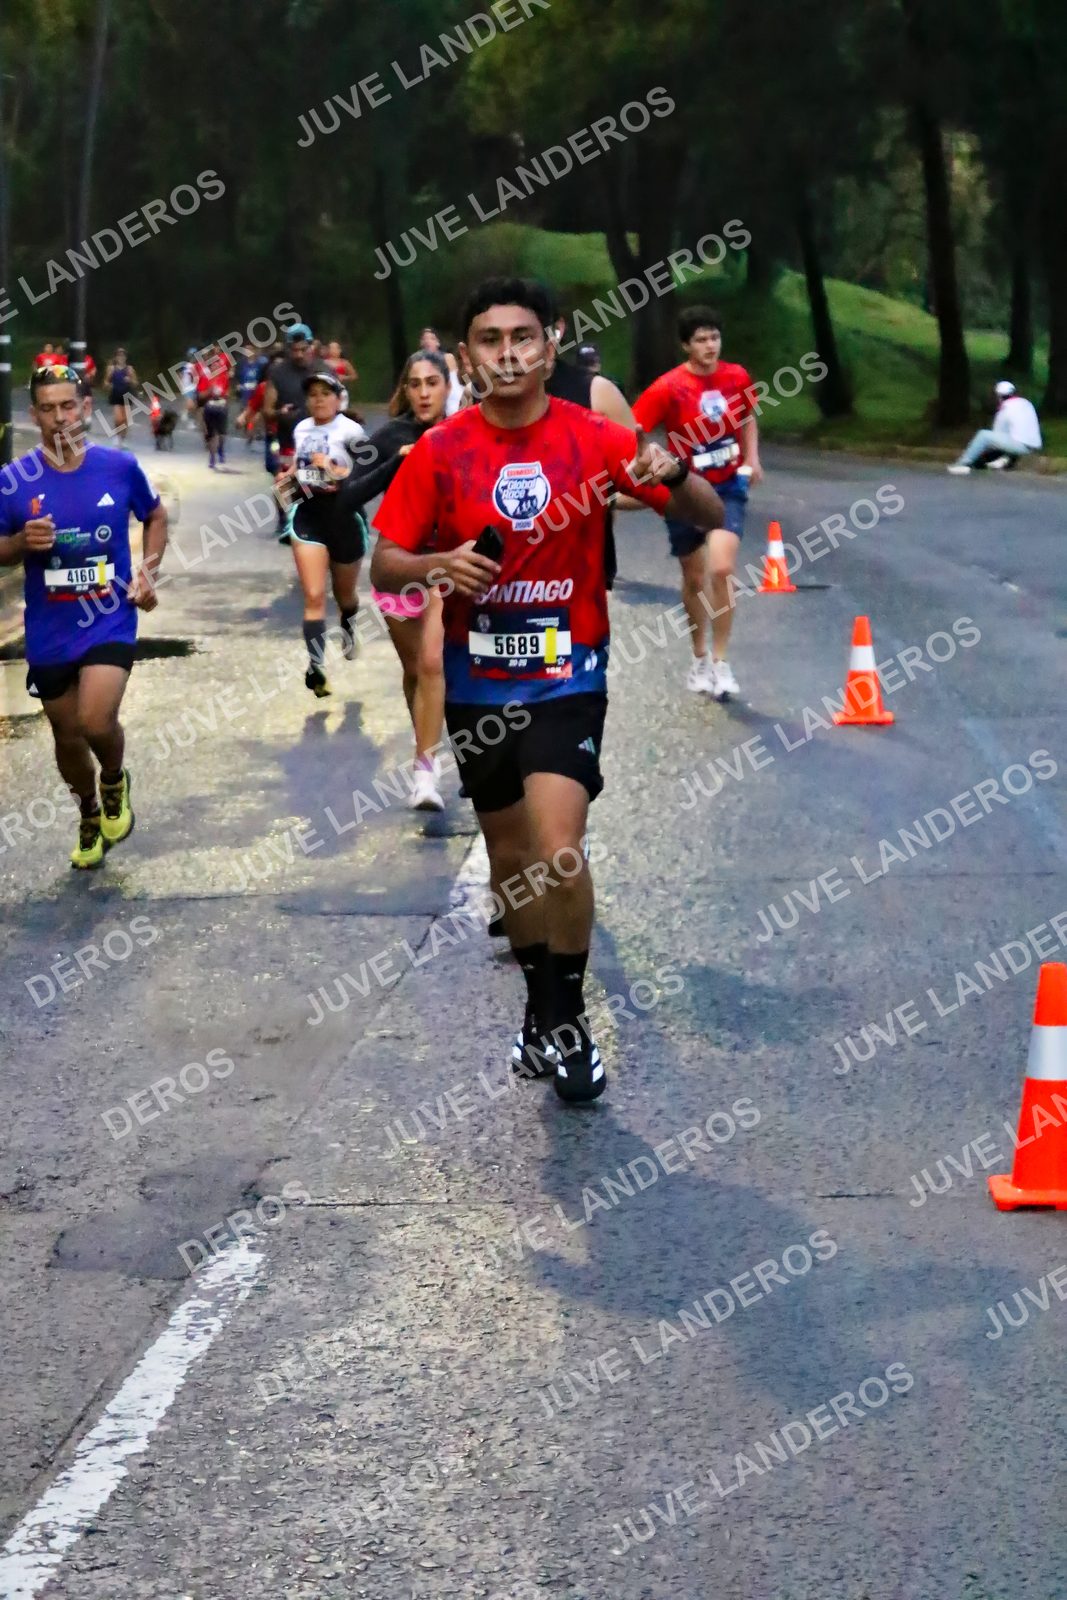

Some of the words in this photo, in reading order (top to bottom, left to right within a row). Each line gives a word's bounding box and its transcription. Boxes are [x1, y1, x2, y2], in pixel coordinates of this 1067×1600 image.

[507, 479, 537, 490] Global
[502, 489, 526, 500] Race
[66, 568, 96, 583] 4160
[494, 635, 540, 655] 5689
